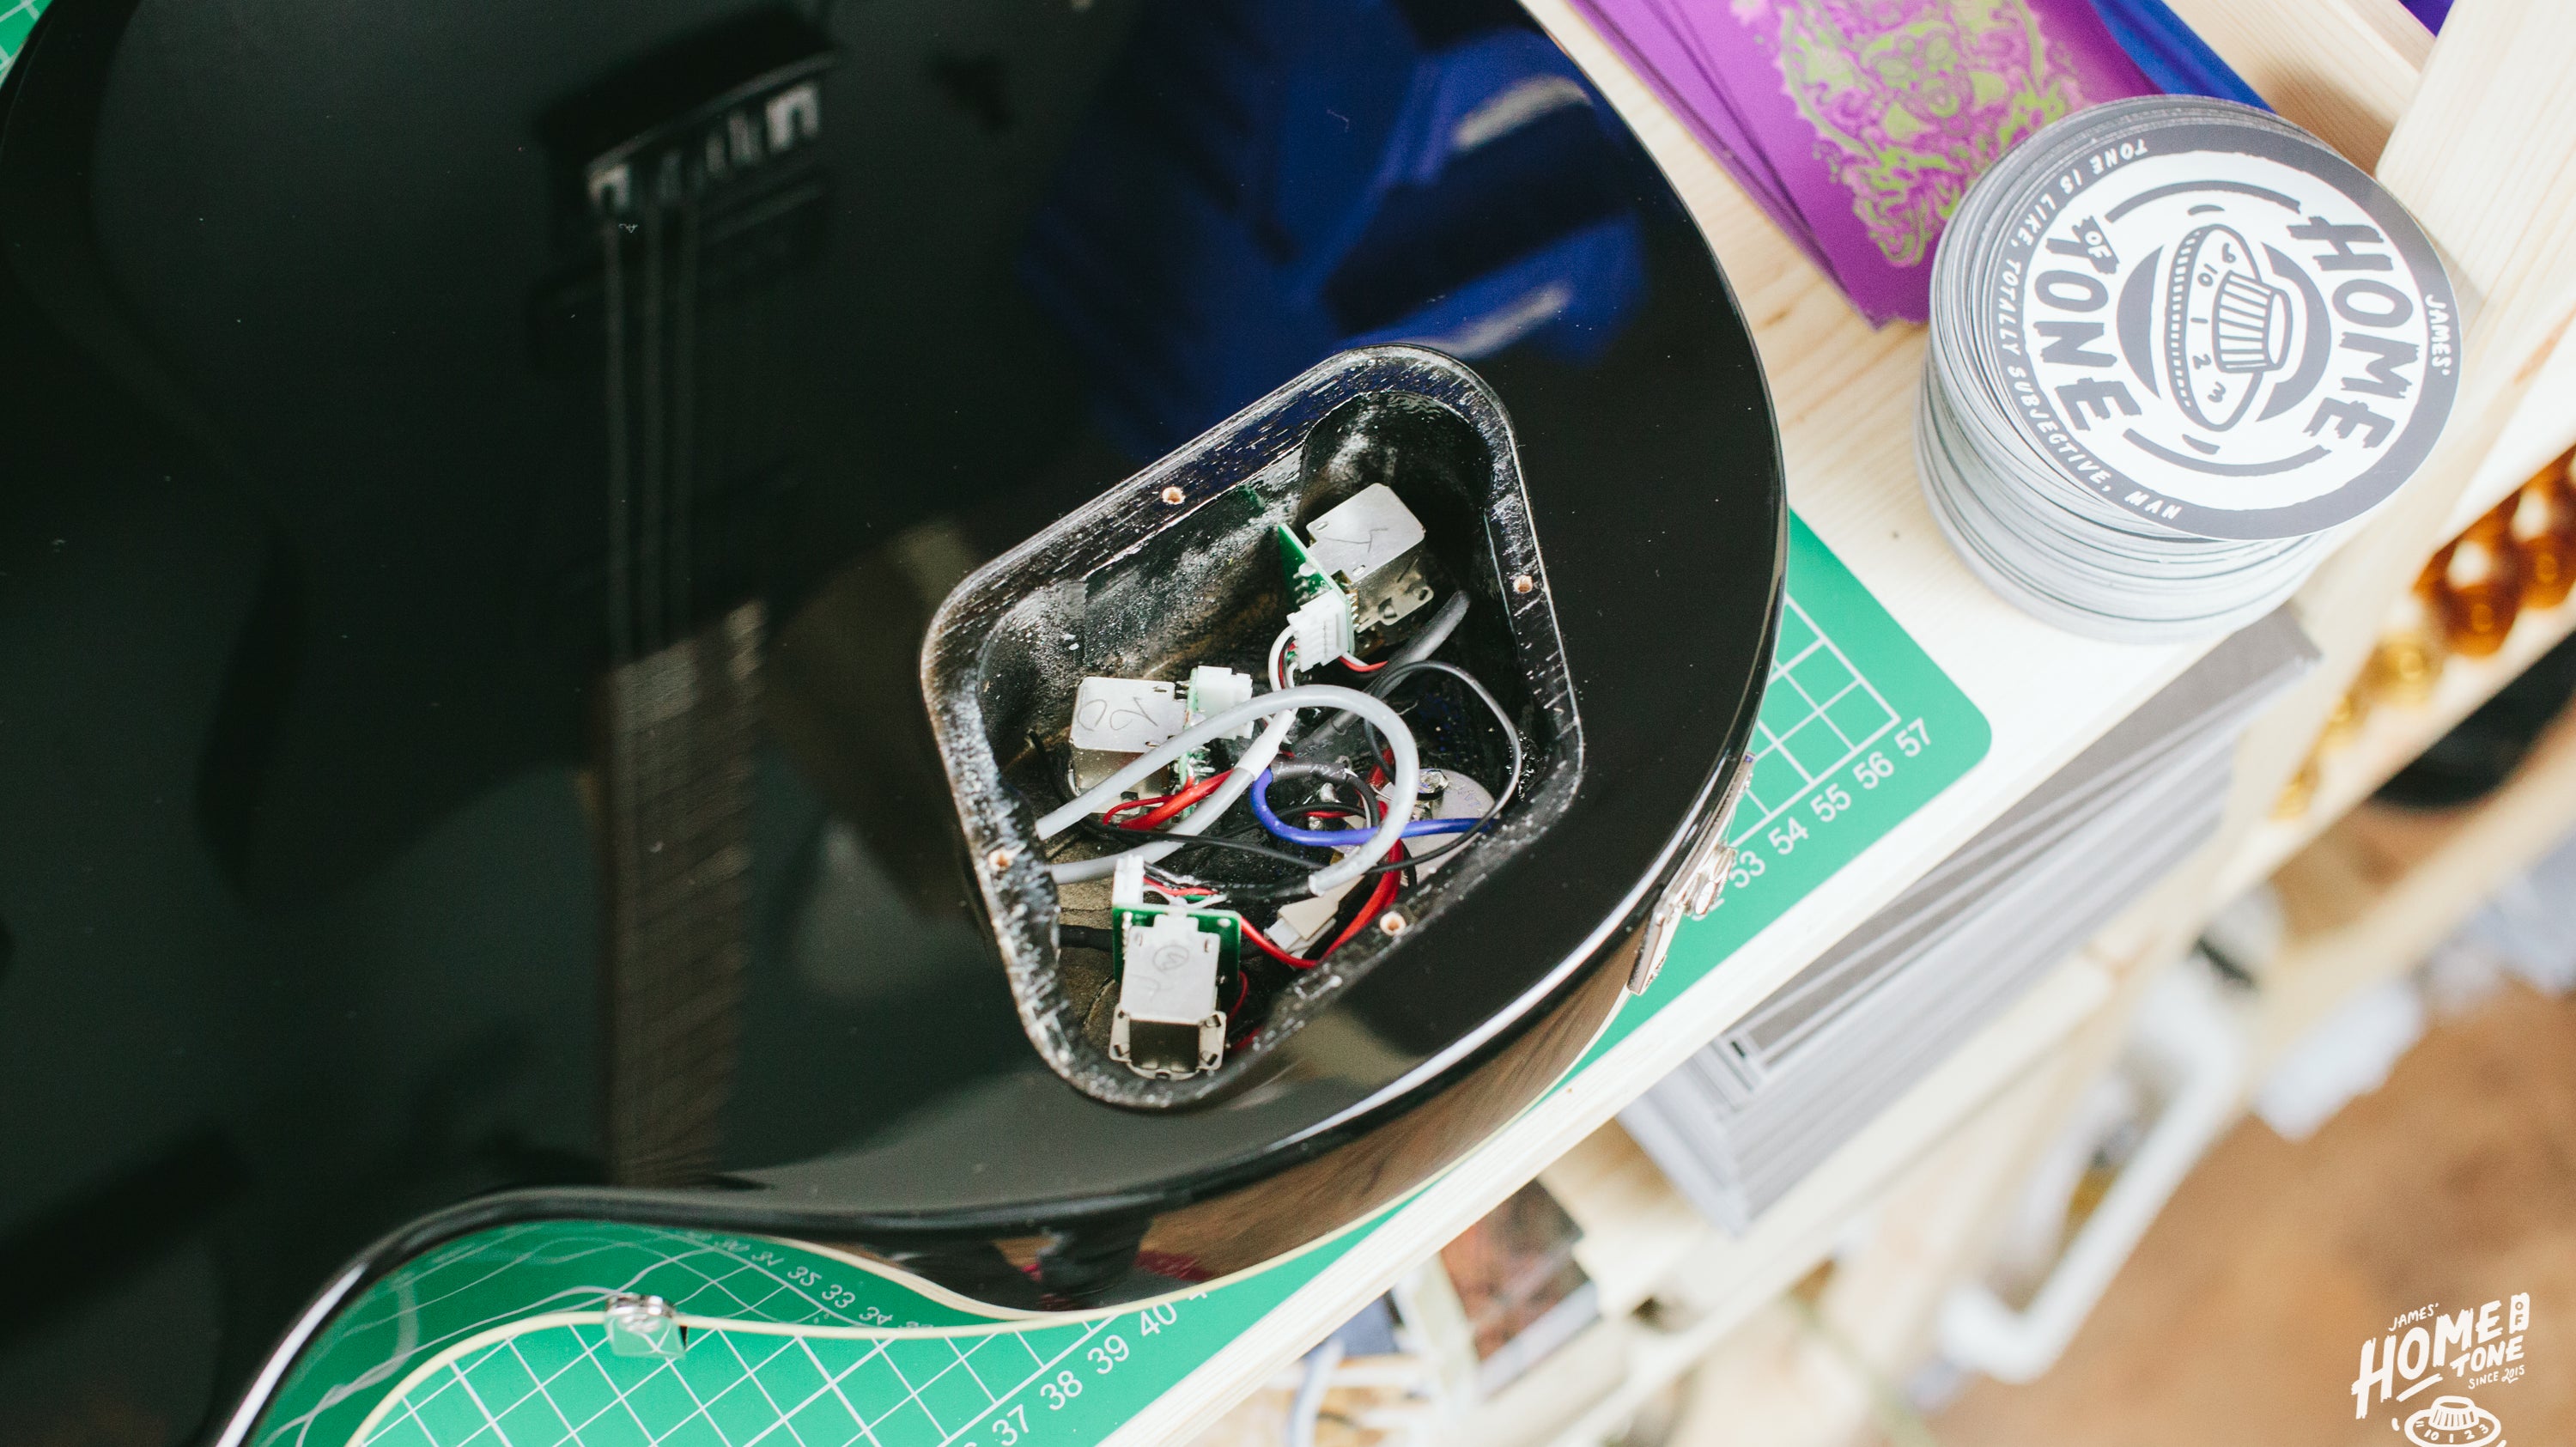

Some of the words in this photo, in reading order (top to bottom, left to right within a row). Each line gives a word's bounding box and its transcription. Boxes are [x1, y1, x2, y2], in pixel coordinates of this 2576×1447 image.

[2089, 138, 2148, 175] TONE
[2060, 169, 2082, 194] IS
[2010, 193, 2057, 247] LIKE,
[2085, 230, 2112, 258] OF
[2197, 263, 2218, 287] 10
[1998, 259, 2022, 356] TOTALLY
[2033, 216, 2142, 431] TONE
[2286, 216, 2420, 448] HOME
[2192, 353, 2212, 370] 2
[2207, 381, 2227, 403] 3
[2008, 366, 2111, 492] SUBJECTIVE,
[2124, 490, 2183, 520] MAN
[1728, 850, 1765, 889] 53
[1768, 817, 1809, 855] 54
[1810, 783, 1852, 823] 55
[1852, 751, 1895, 790] 56
[1894, 717, 1931, 758] 57
[992, 1403, 1030, 1447] 37
[1040, 1370, 1083, 1411] 38
[1087, 1335, 1130, 1375] 39
[1139, 1302, 1177, 1337] 40
